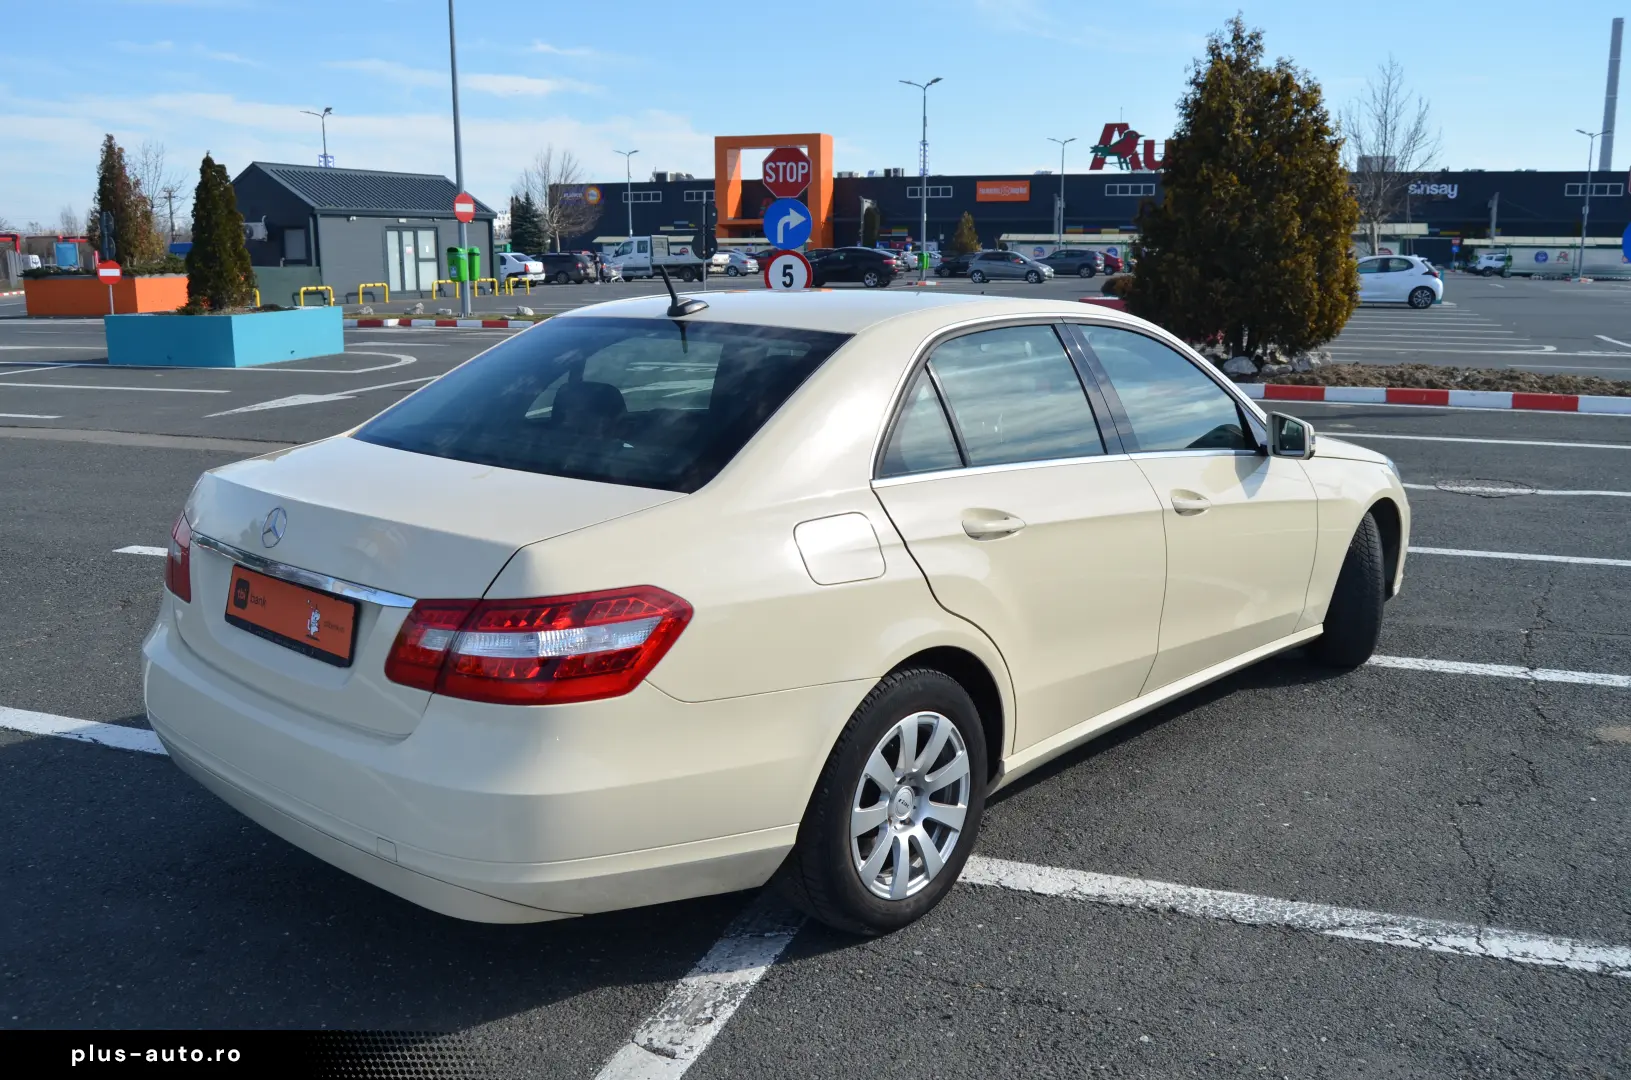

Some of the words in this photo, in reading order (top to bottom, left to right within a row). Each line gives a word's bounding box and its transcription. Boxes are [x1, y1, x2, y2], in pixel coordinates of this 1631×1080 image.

[1089, 123, 1174, 170] Au
[765, 161, 809, 183] STOP
[1408, 180, 1459, 199] sinsay
[781, 264, 794, 288] 5
[250, 593, 267, 609] bank
